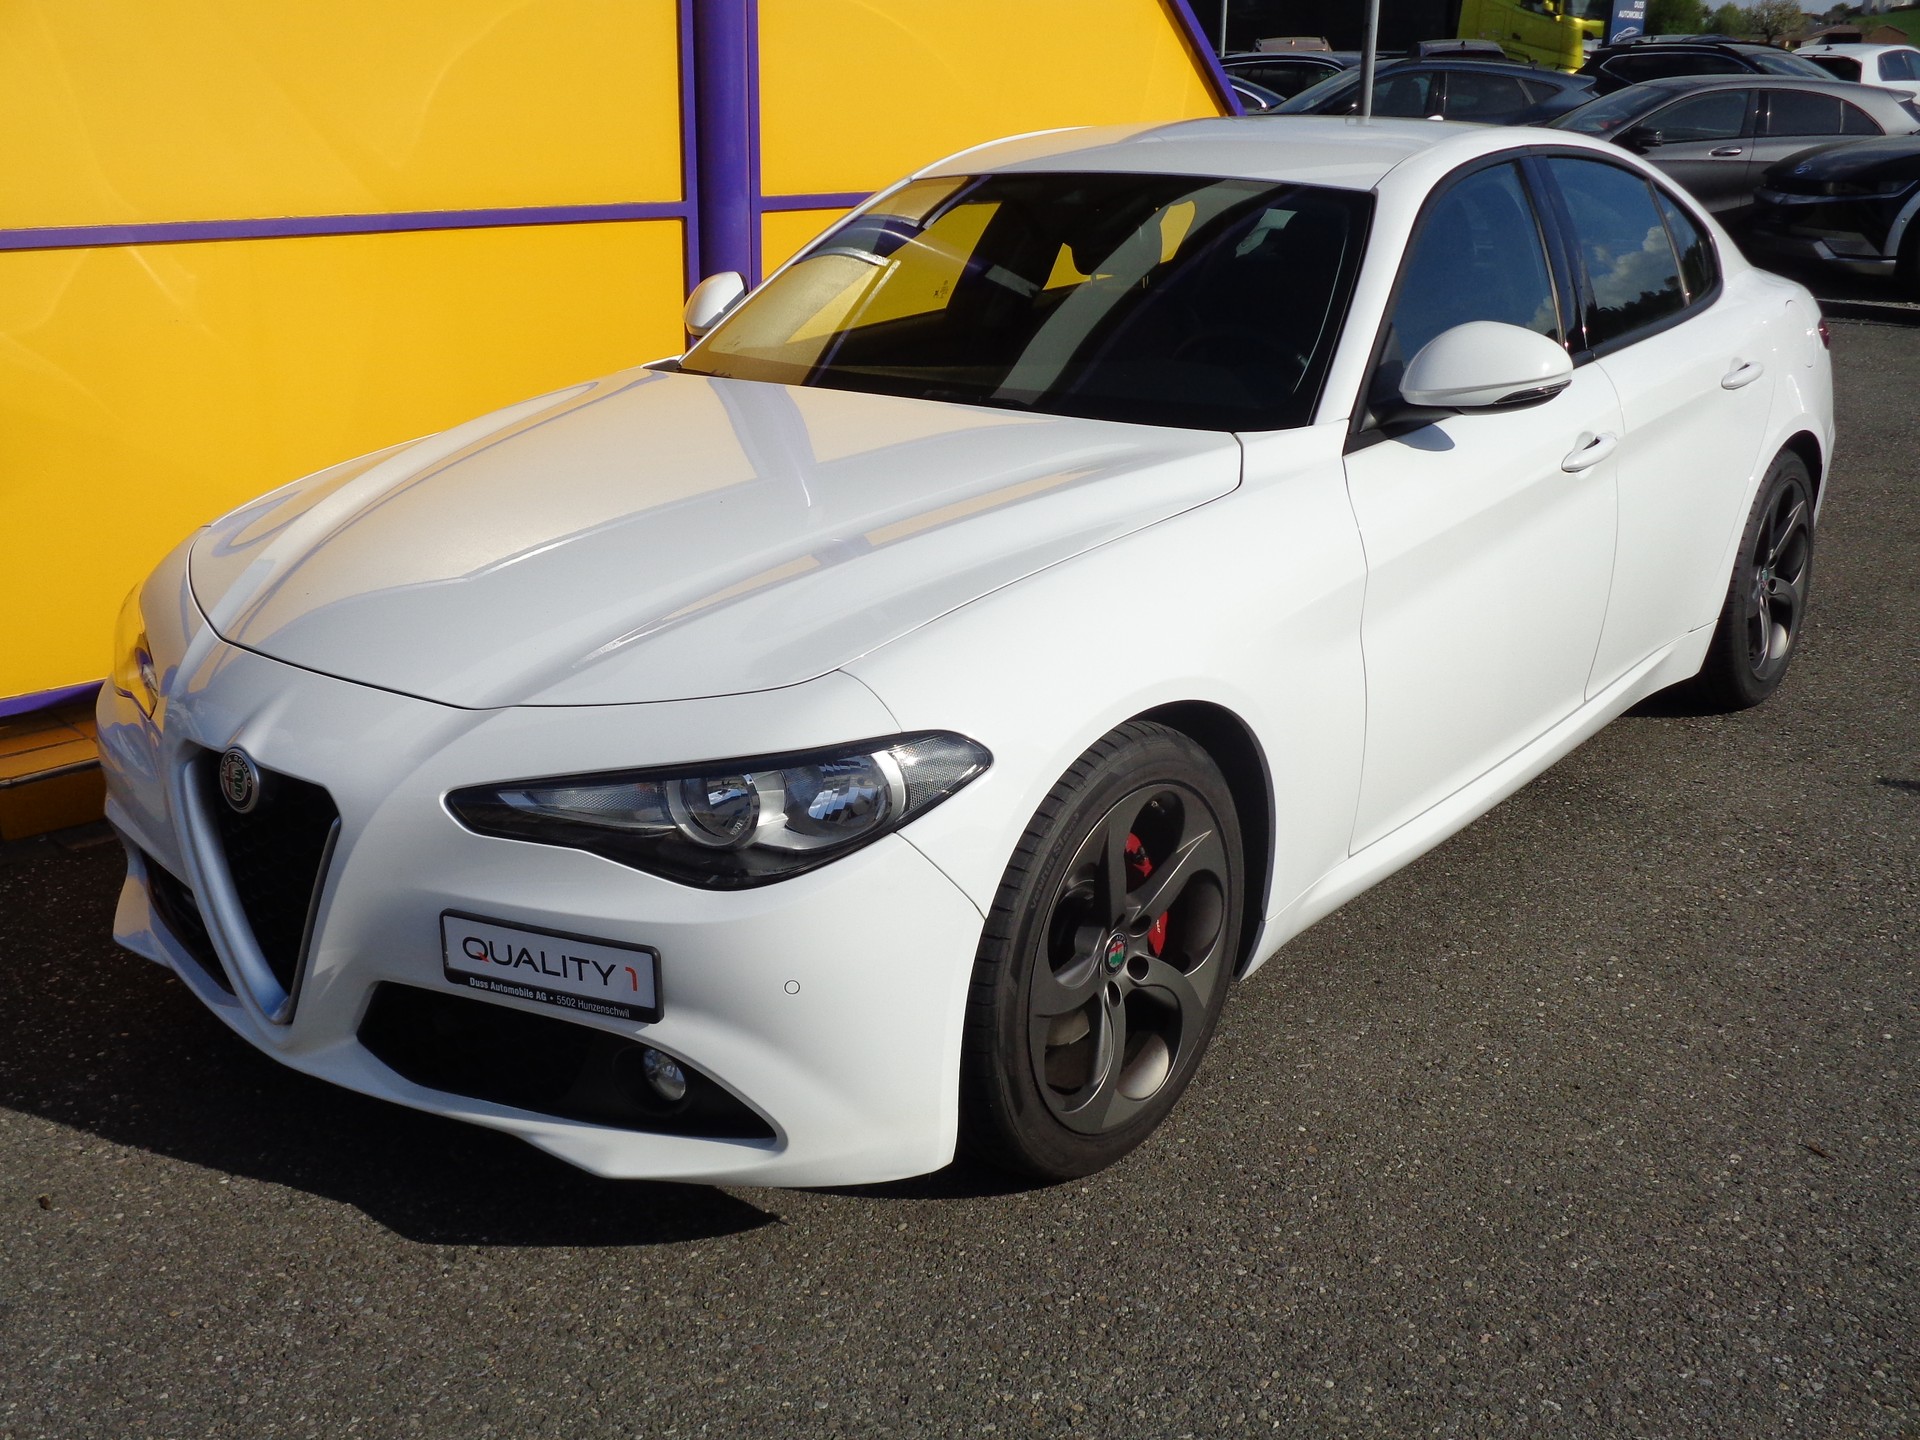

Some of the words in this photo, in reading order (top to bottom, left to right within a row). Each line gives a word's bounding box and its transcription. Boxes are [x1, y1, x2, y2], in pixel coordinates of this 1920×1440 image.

[1618, 10, 1644, 19] AUTOMOBILE
[462, 936, 616, 986] QUALITY
[625, 966, 638, 992] 1
[469, 977, 489, 989] Duss
[490, 981, 534, 998] Automobile
[536, 991, 547, 1001] AG
[556, 995, 576, 1007] 5502
[577, 1000, 630, 1018] Hunzenschwil
